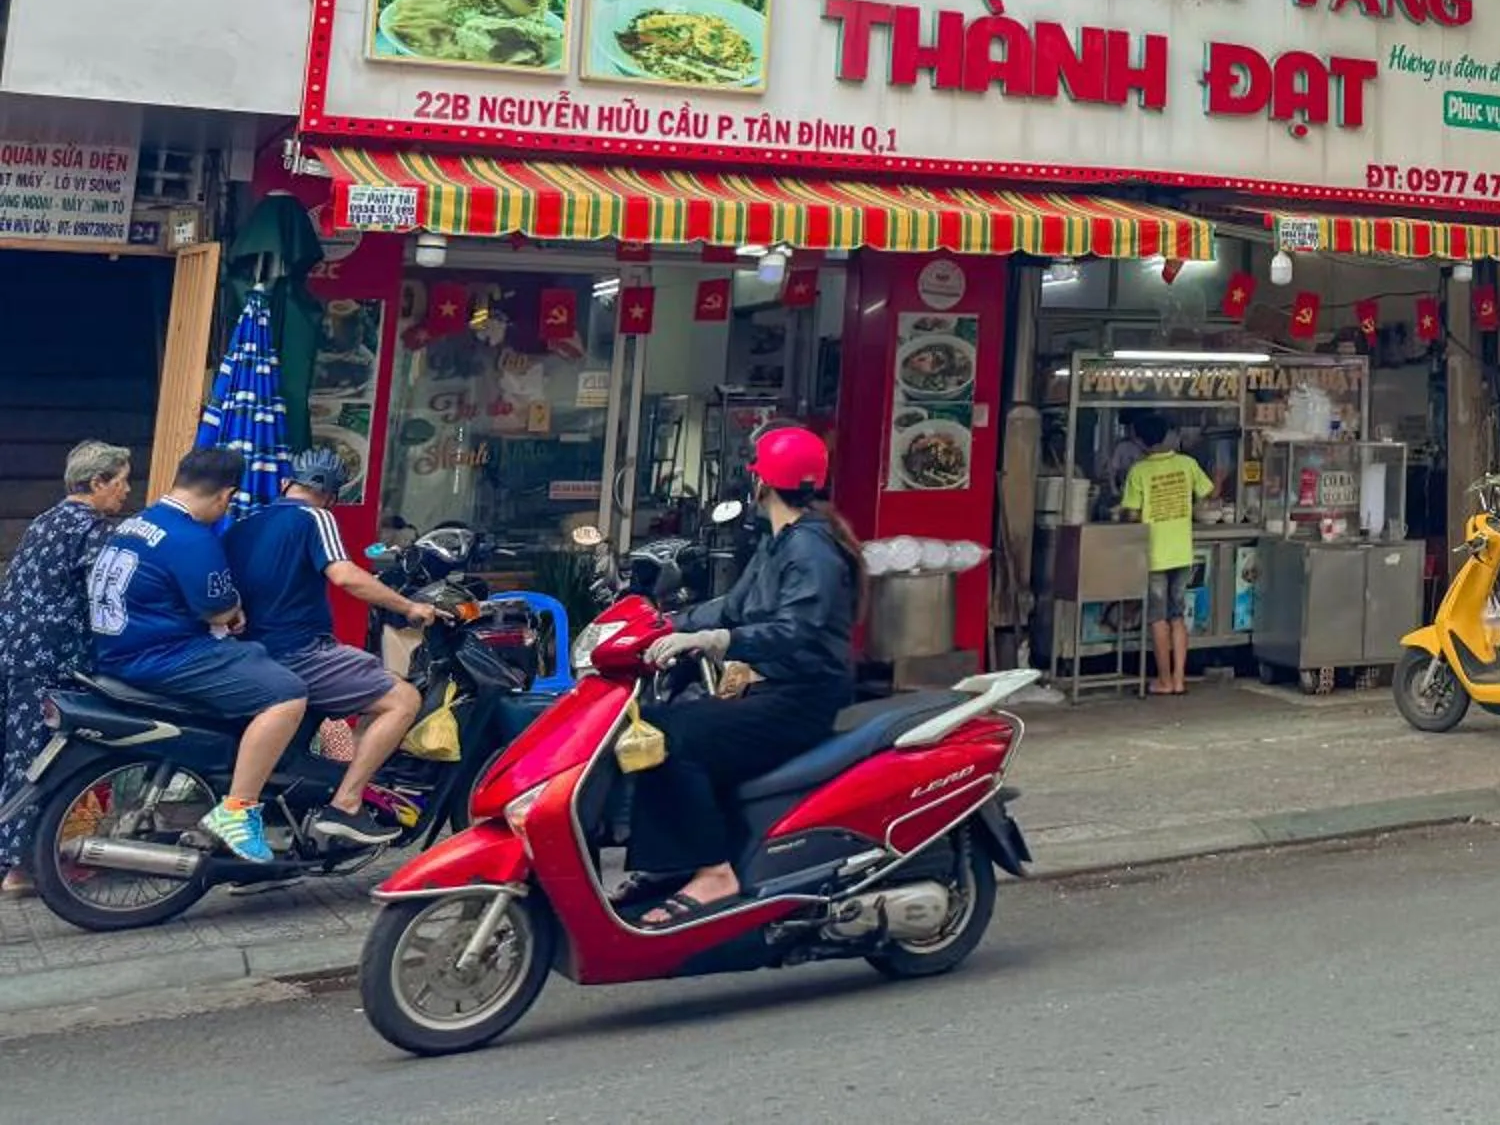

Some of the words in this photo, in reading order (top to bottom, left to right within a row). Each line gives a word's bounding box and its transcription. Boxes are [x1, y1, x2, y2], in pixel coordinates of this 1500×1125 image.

[1201, 40, 1378, 138] ĐẠT
[414, 90, 470, 121] 22B
[477, 88, 589, 131] NGUYỄN
[596, 96, 649, 135] HỮU
[658, 100, 709, 138] CẦU
[716, 116, 739, 142] P.
[744, 111, 793, 146] TÂN
[797, 119, 856, 154] ĐỊNH
[1448, 96, 1483, 123] Phục
[1406, 167, 1469, 193] 0977
[910, 764, 976, 799] LEAD
